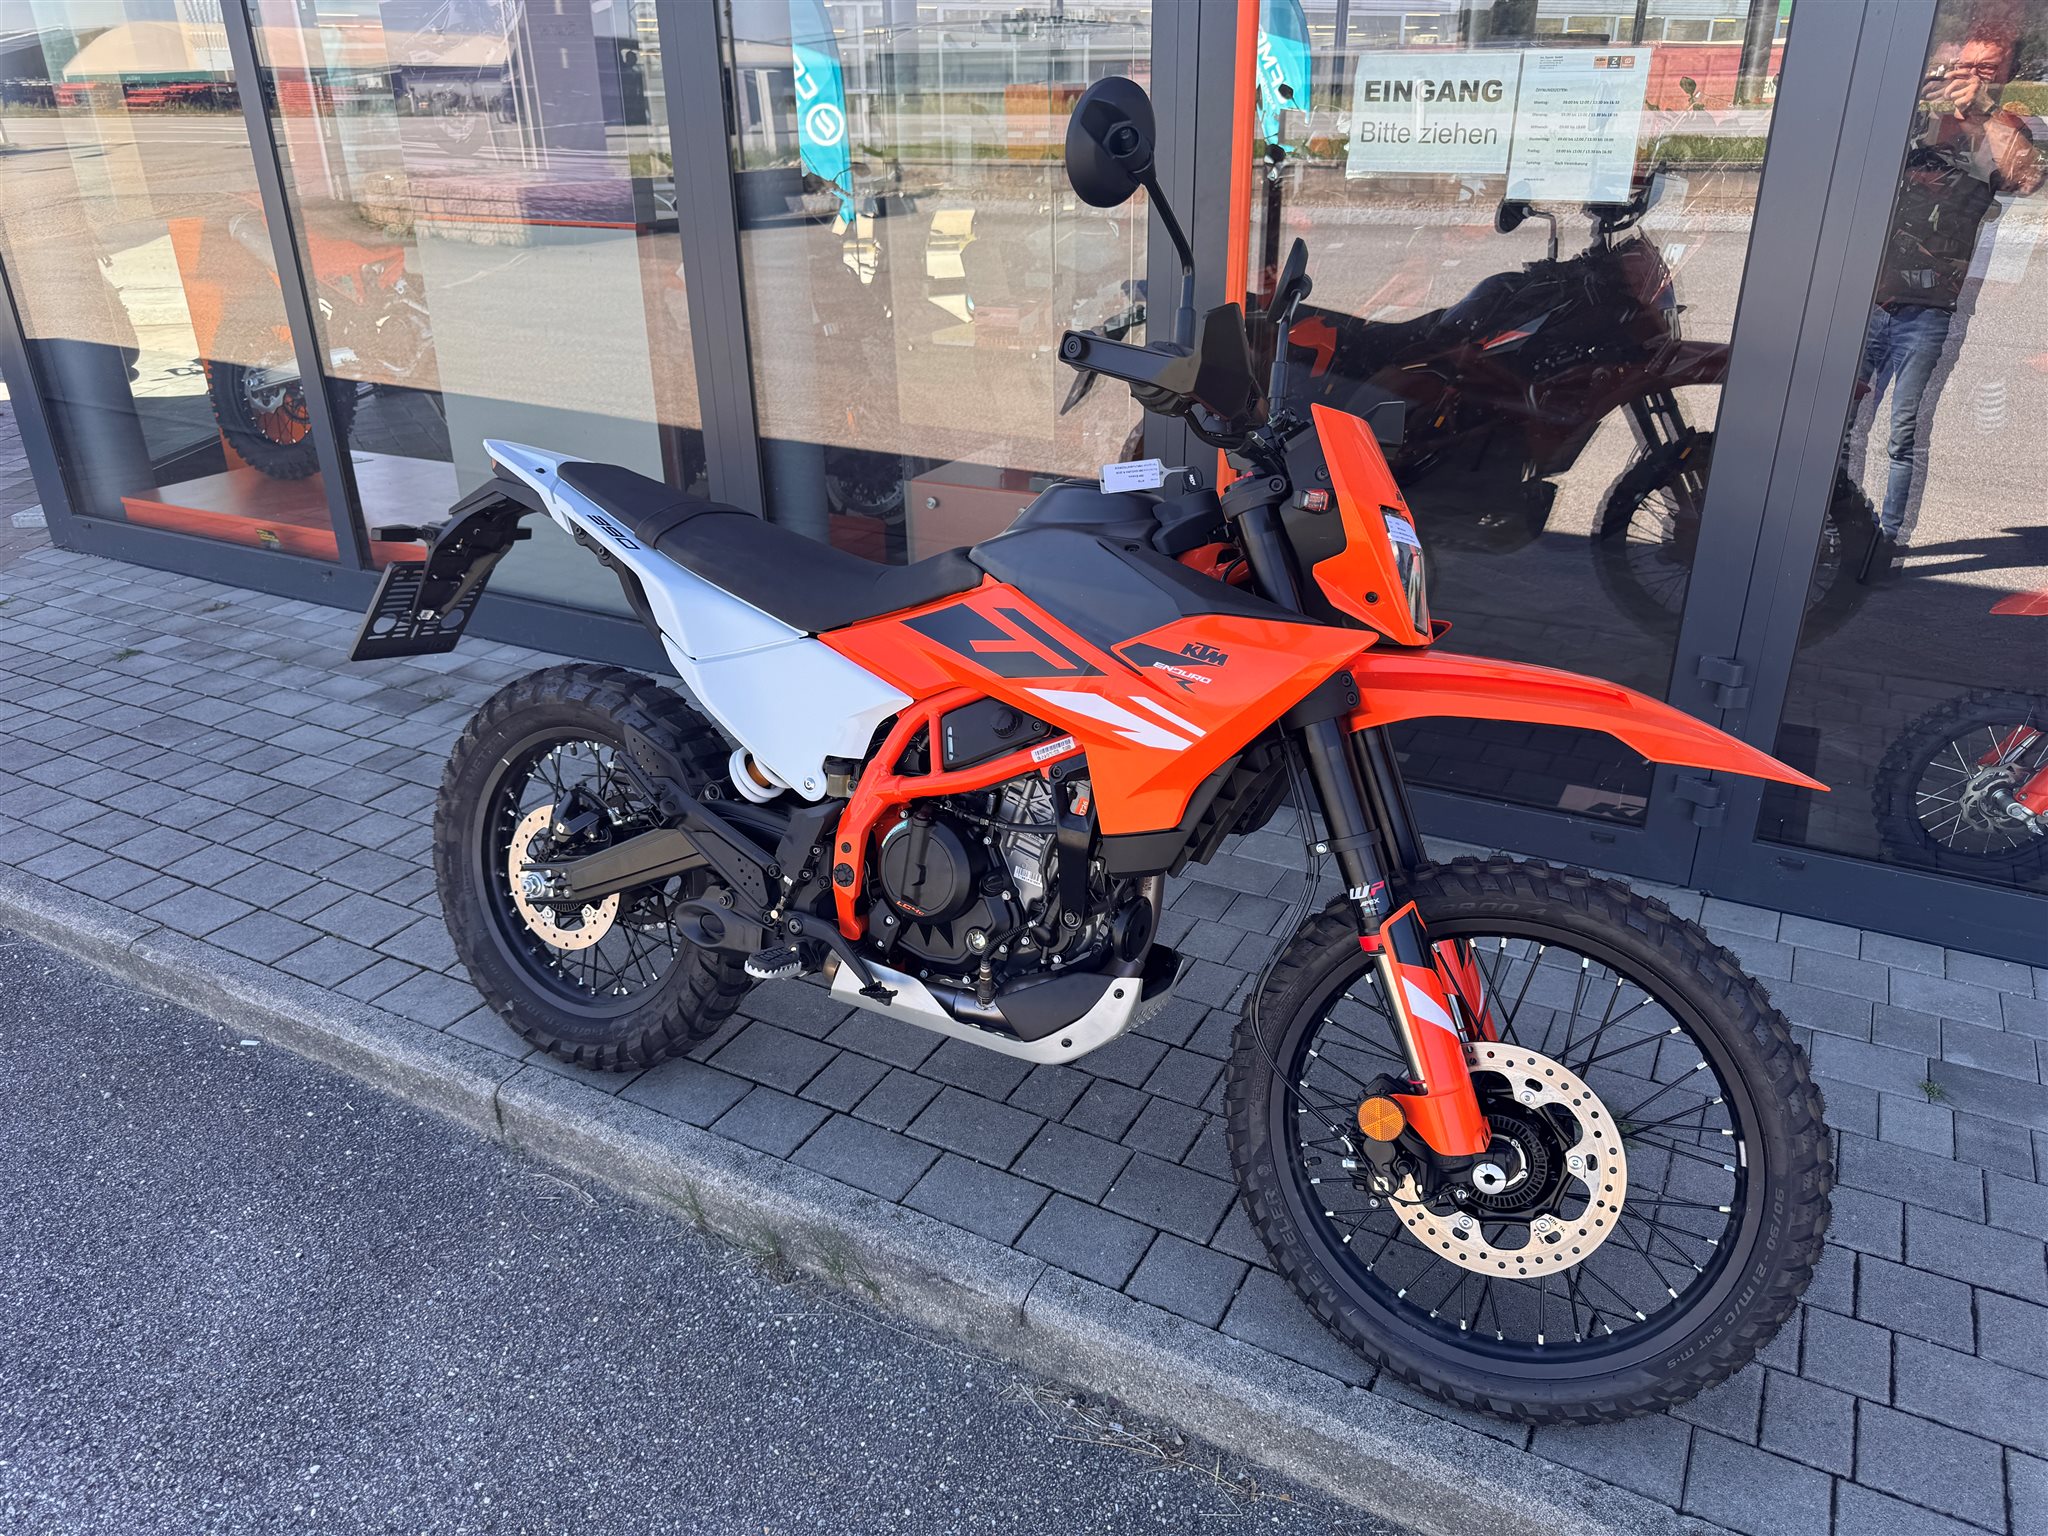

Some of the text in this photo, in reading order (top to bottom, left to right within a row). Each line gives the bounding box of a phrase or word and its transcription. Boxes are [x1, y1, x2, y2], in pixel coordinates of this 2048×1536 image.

[1364, 79, 1503, 103] EINGANG
[1360, 121, 1498, 145] Bitte ziehen
[586, 514, 641, 551] 390
[1179, 642, 1229, 667] KTM
[1152, 661, 1212, 685] ENDURO
[1349, 880, 1385, 900] WP
[1766, 1187, 1785, 1255] 90/90
[1264, 1190, 1338, 1304] METZELER
[1750, 1263, 1768, 1287] 21
